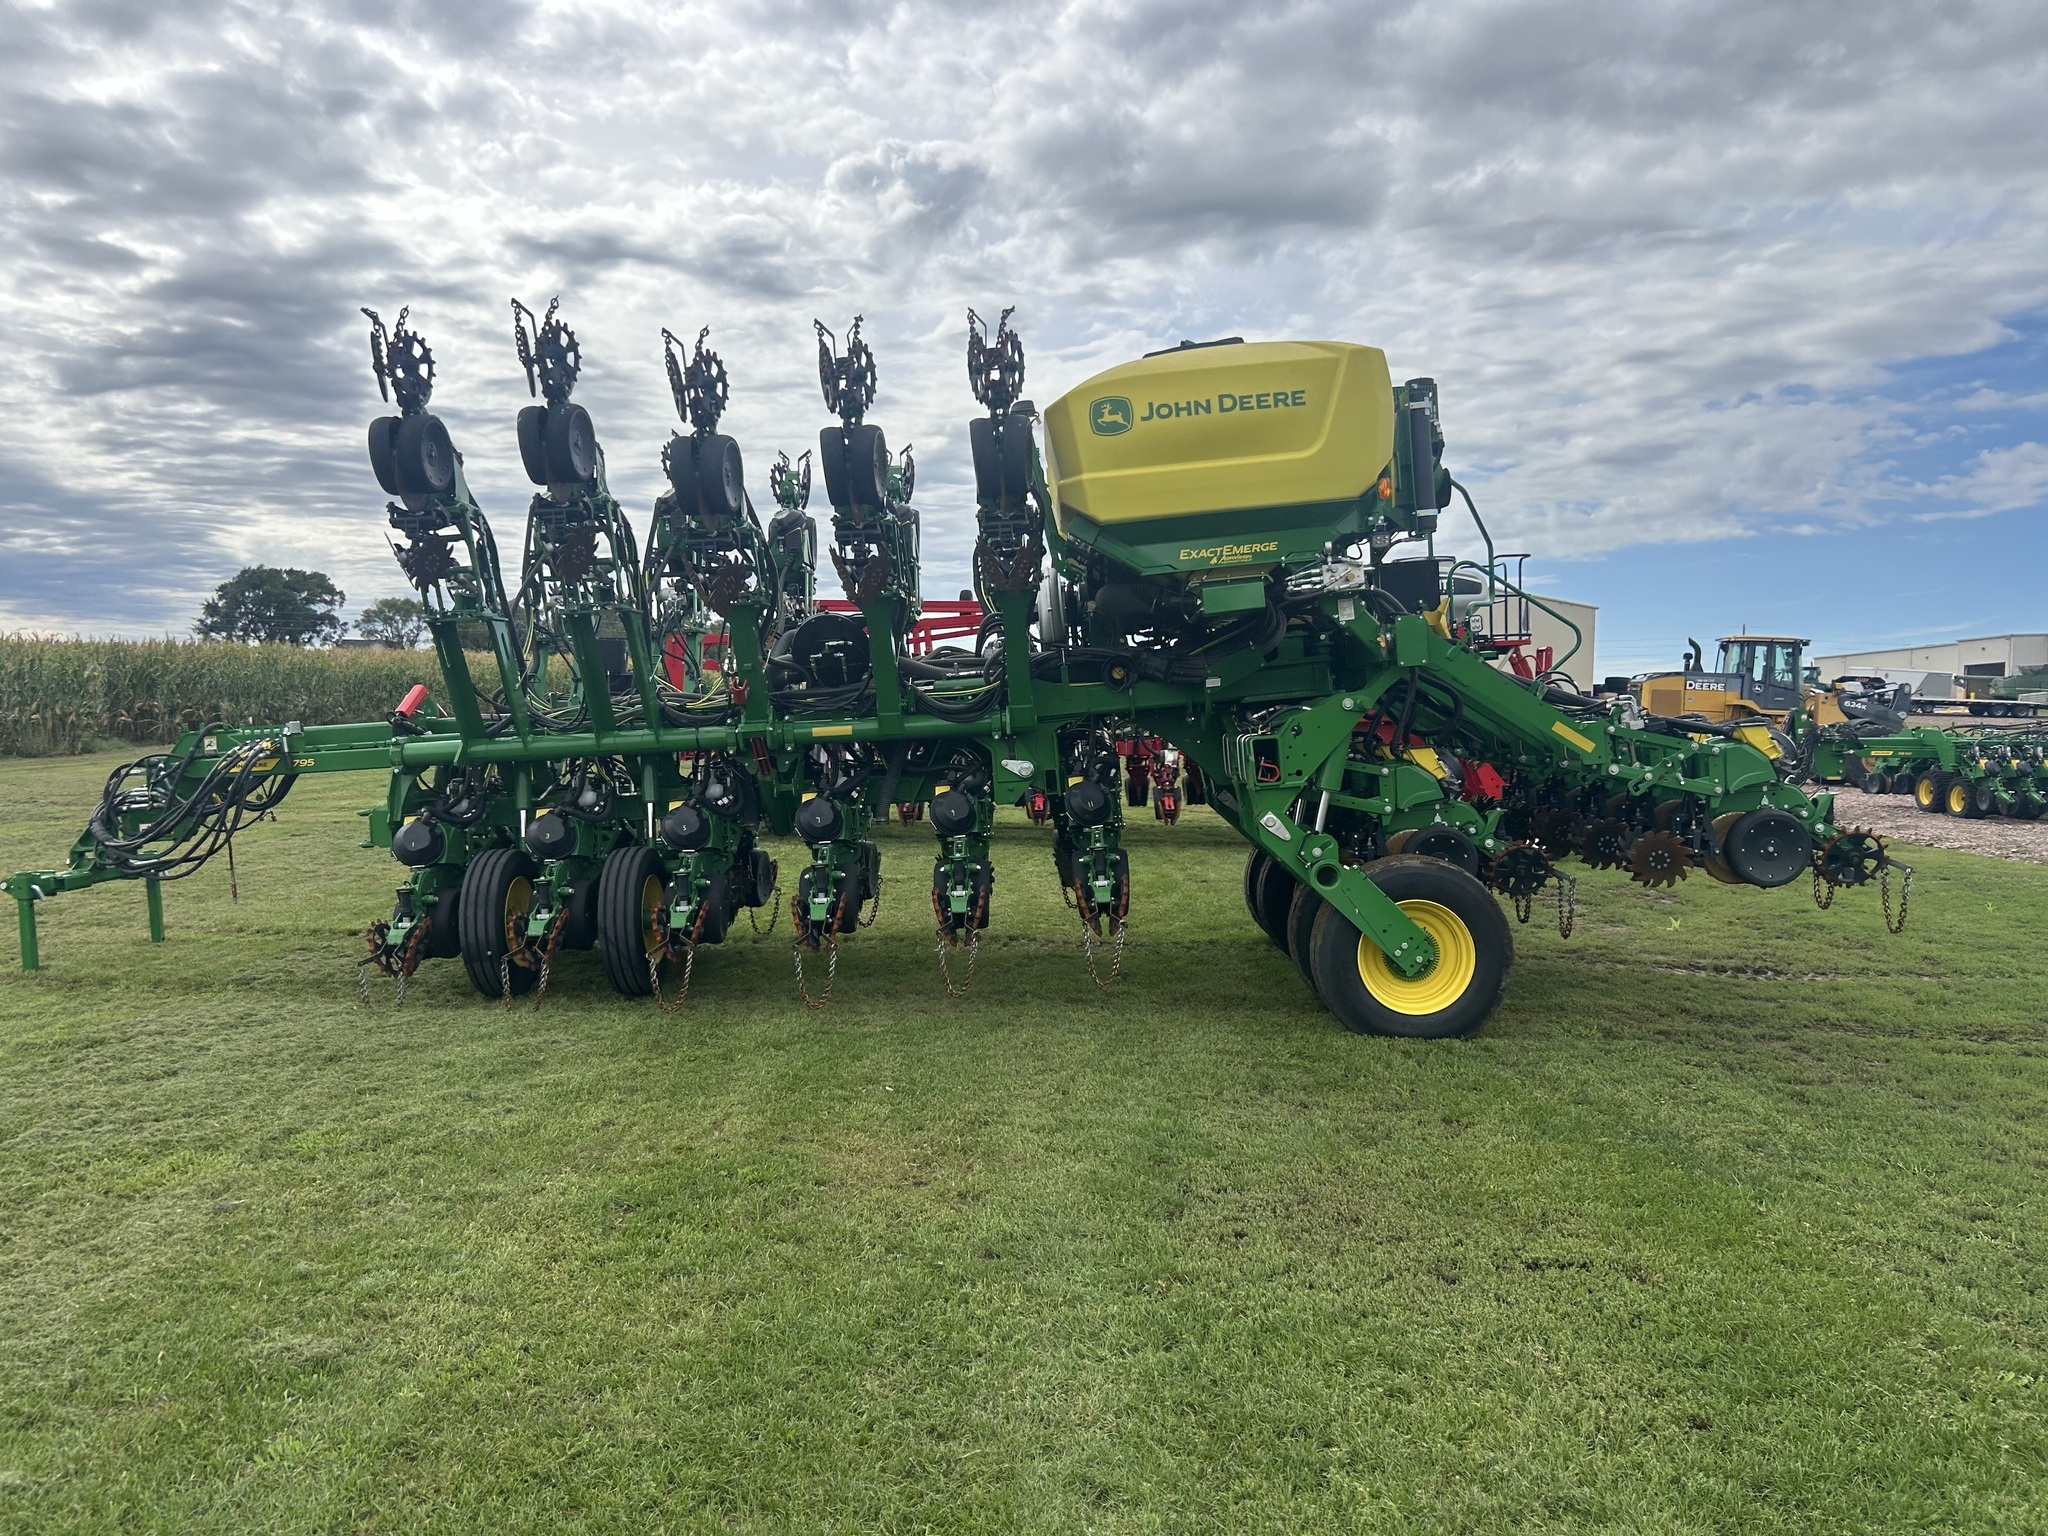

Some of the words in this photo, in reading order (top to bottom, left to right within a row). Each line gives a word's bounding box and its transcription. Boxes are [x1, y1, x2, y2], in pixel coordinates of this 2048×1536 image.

[1140, 398, 1212, 422] JOHN
[1217, 390, 1307, 414] DEERE
[1179, 541, 1279, 560] EXACTEMERGE
[1686, 680, 1725, 691] DEERE
[1843, 700, 1867, 710] 624K
